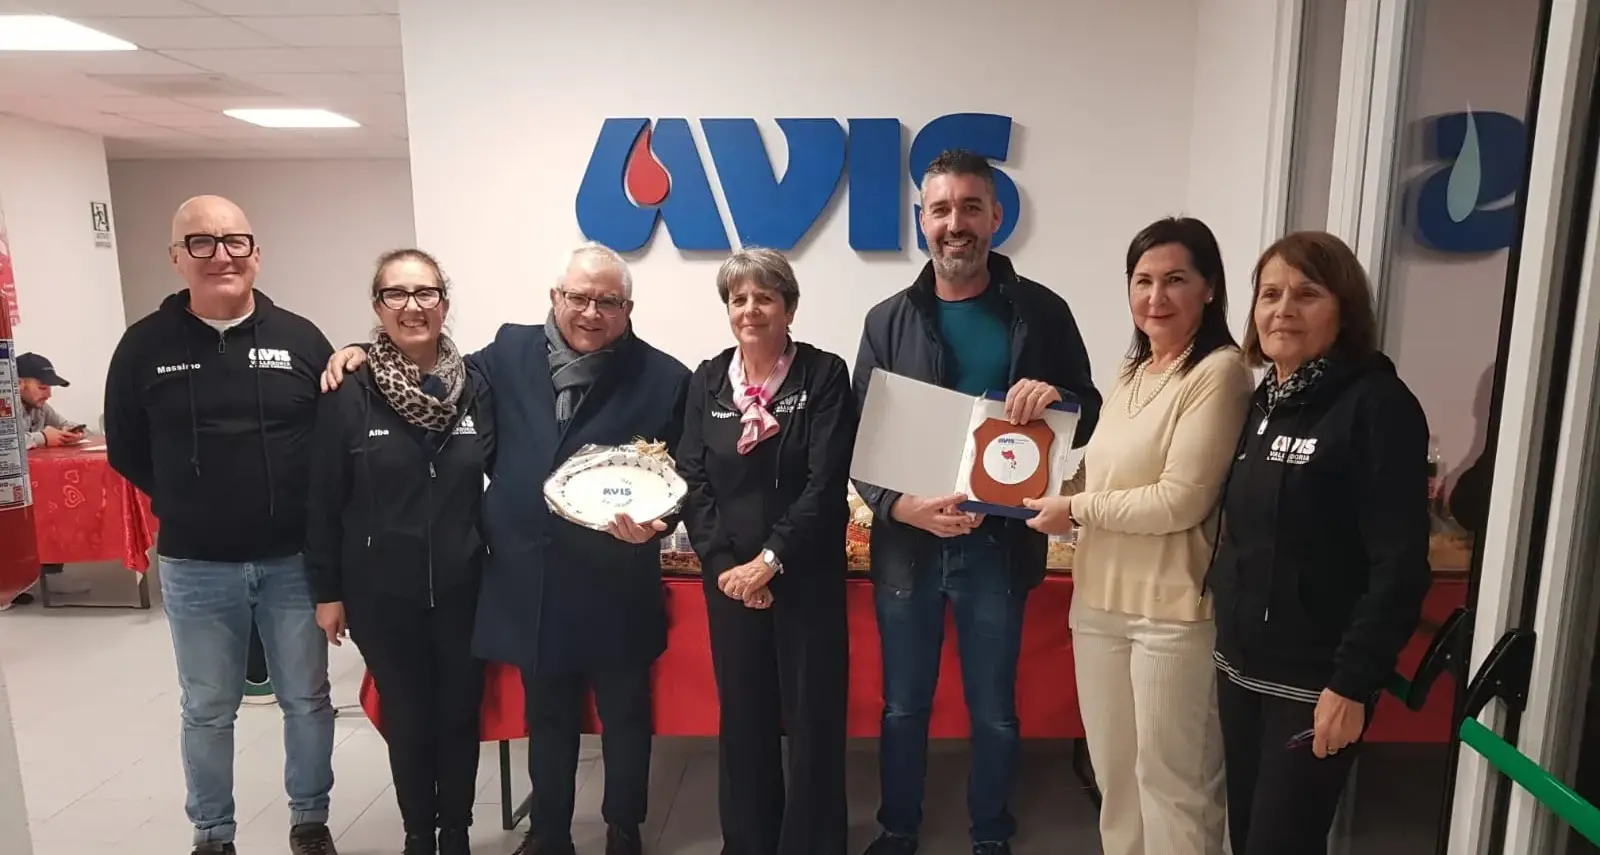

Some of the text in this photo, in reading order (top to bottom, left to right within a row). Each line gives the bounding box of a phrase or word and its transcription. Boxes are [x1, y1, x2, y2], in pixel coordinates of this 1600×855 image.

[575, 113, 1020, 252] AVIS
[368, 429, 390, 437] Alba
[602, 488, 632, 496] AVIS
